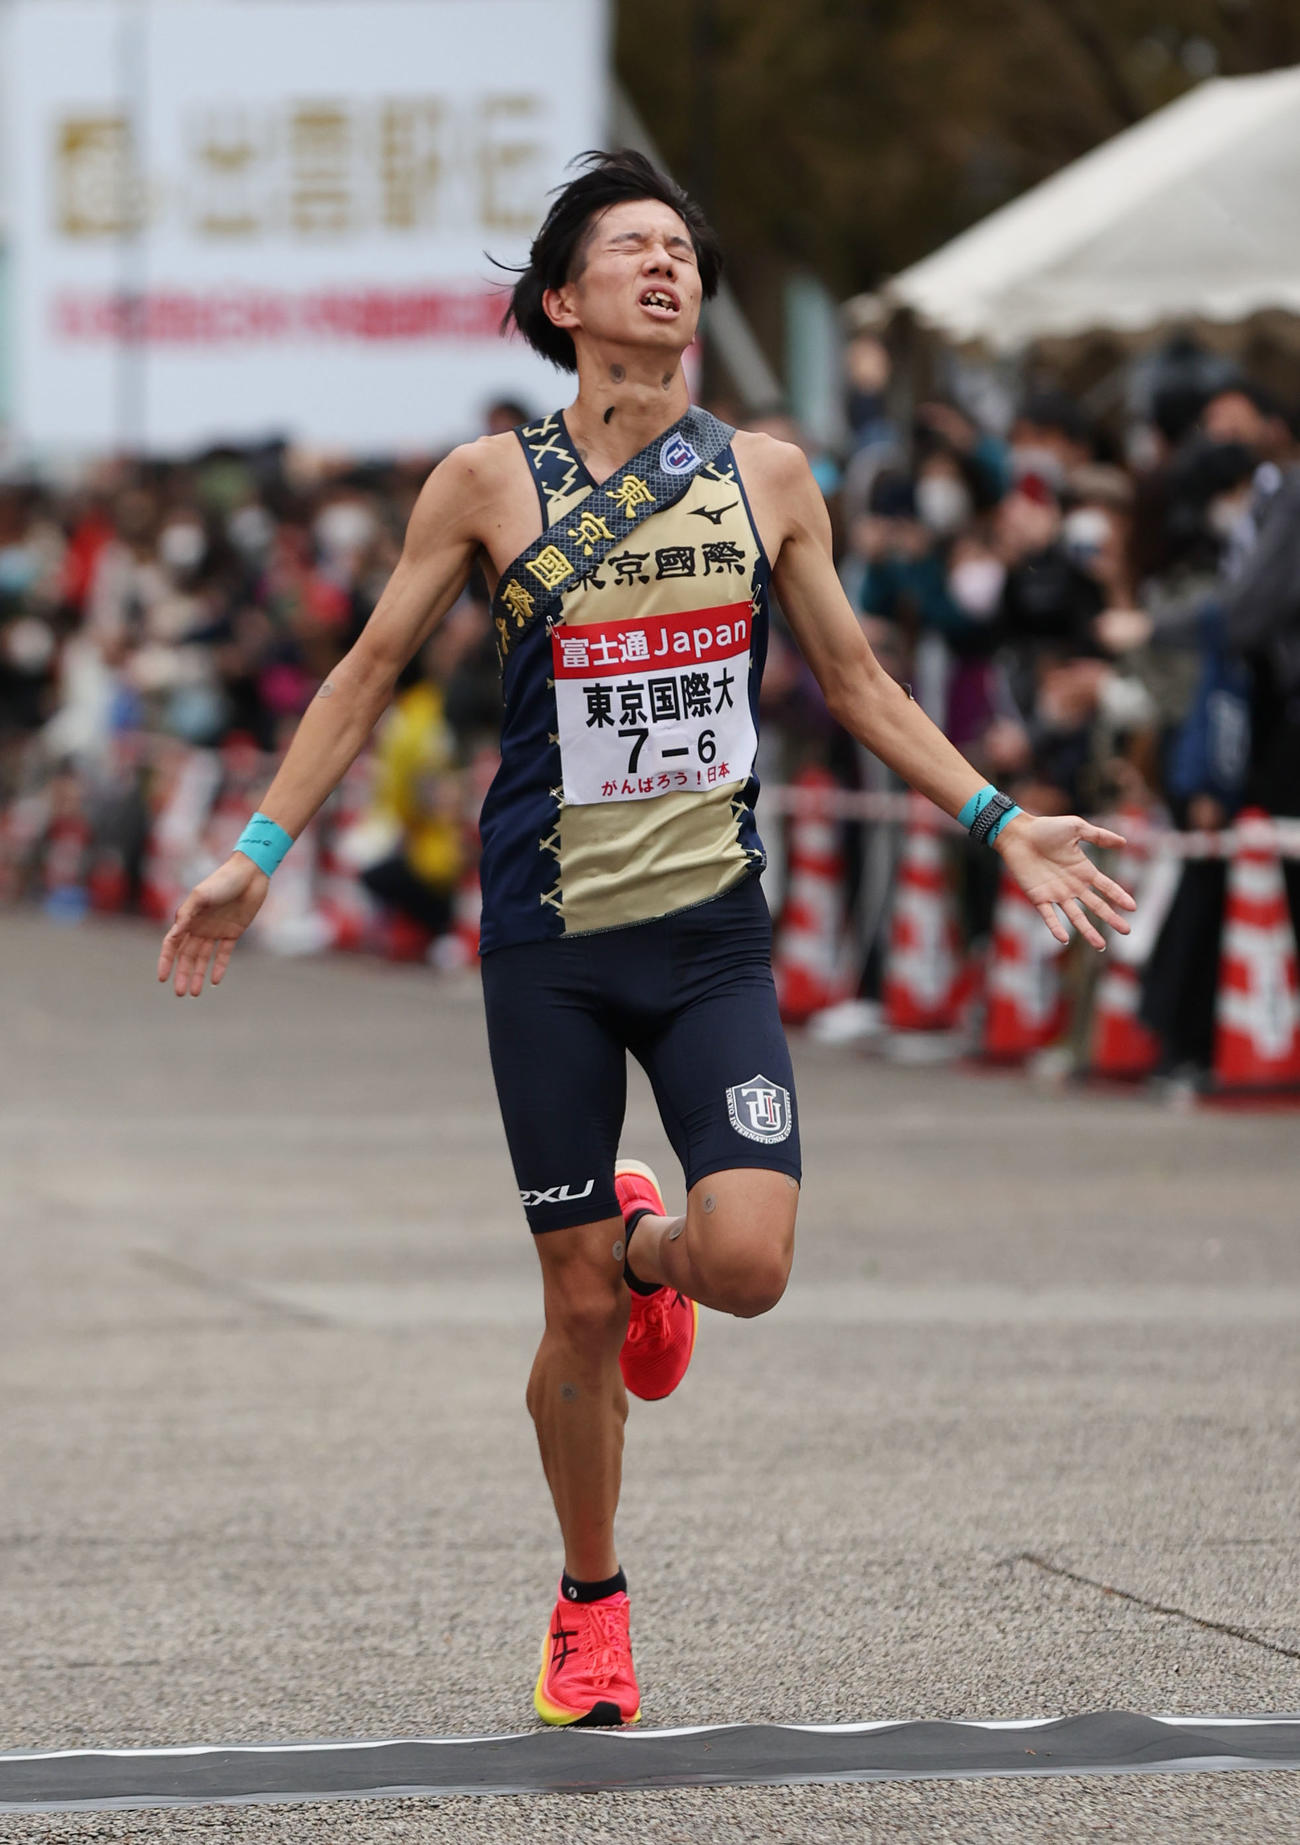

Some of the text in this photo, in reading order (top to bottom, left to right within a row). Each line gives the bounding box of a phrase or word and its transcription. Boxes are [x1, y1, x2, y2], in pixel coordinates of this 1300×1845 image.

[583, 667, 735, 728] 東京国際大
